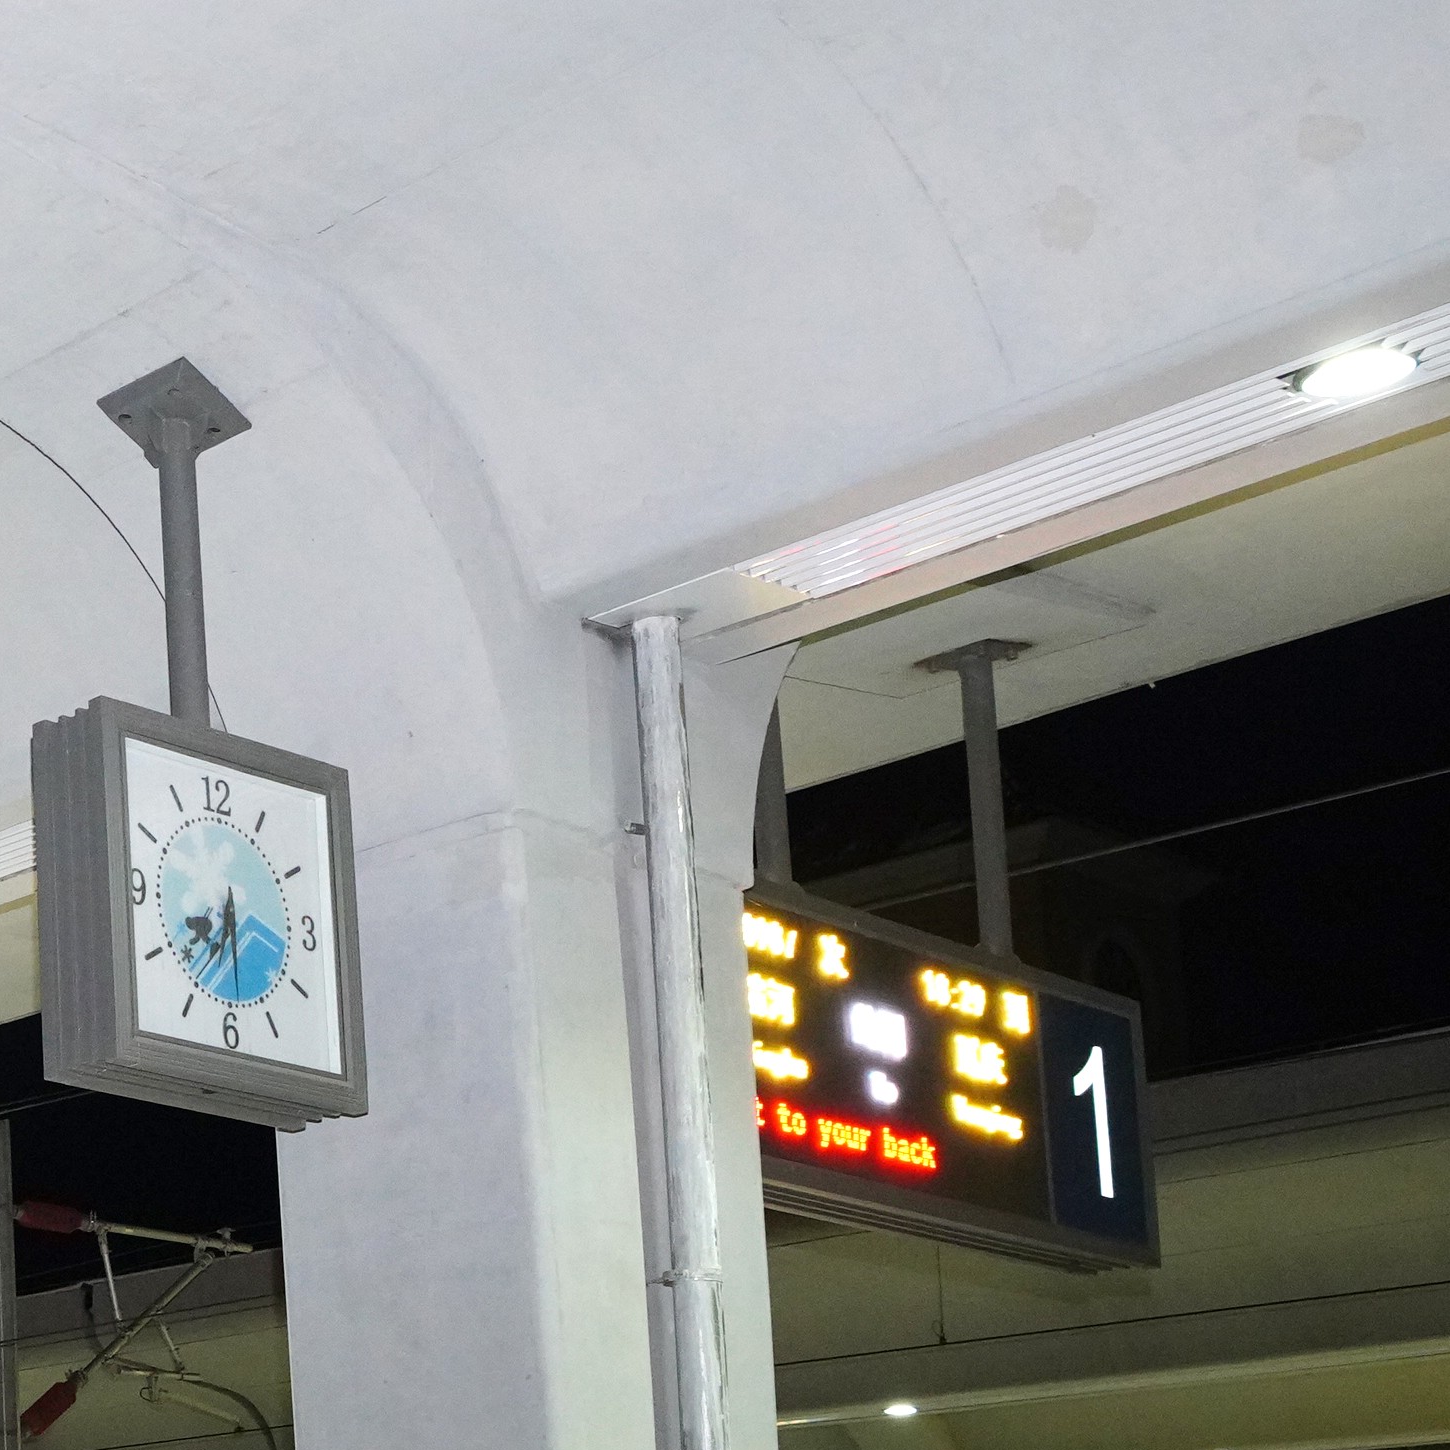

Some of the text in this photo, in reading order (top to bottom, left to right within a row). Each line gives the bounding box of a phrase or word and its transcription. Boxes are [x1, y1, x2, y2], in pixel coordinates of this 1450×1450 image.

[200, 776, 231, 816] 12
[131, 867, 147, 905] 9
[301, 915, 316, 952] 3
[222, 1011, 240, 1050] 6
[776, 1102, 808, 1136] to
[817, 1118, 872, 1152] your
[883, 1126, 937, 1169] back
[1072, 1045, 1115, 1199] 1
